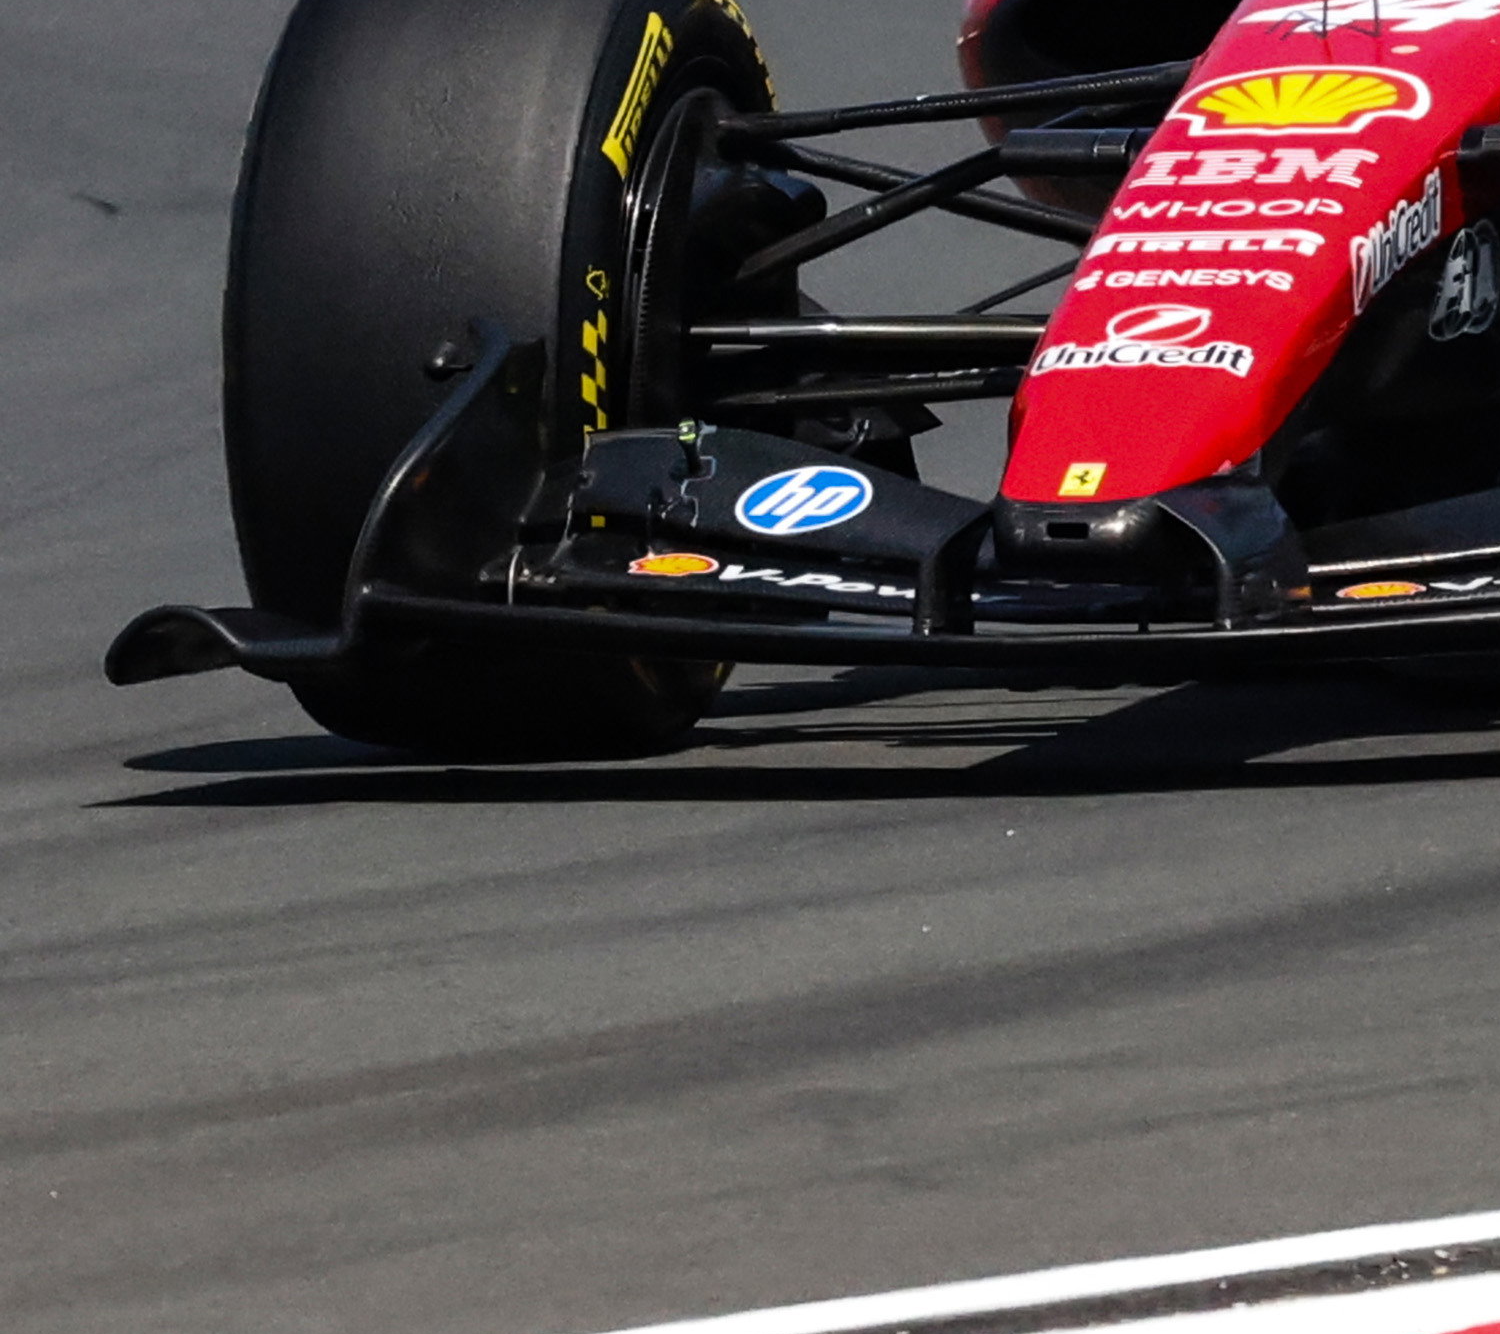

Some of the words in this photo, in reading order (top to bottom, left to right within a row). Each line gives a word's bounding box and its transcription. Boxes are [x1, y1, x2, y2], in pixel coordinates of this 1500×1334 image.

[1128, 148, 1380, 189] IBM
[1113, 198, 1344, 219] WHOOP
[1086, 229, 1325, 260] PIRELLI
[1105, 268, 1294, 291] GENESYS
[1031, 341, 1255, 376] UniCredit
[740, 466, 867, 534] hp
